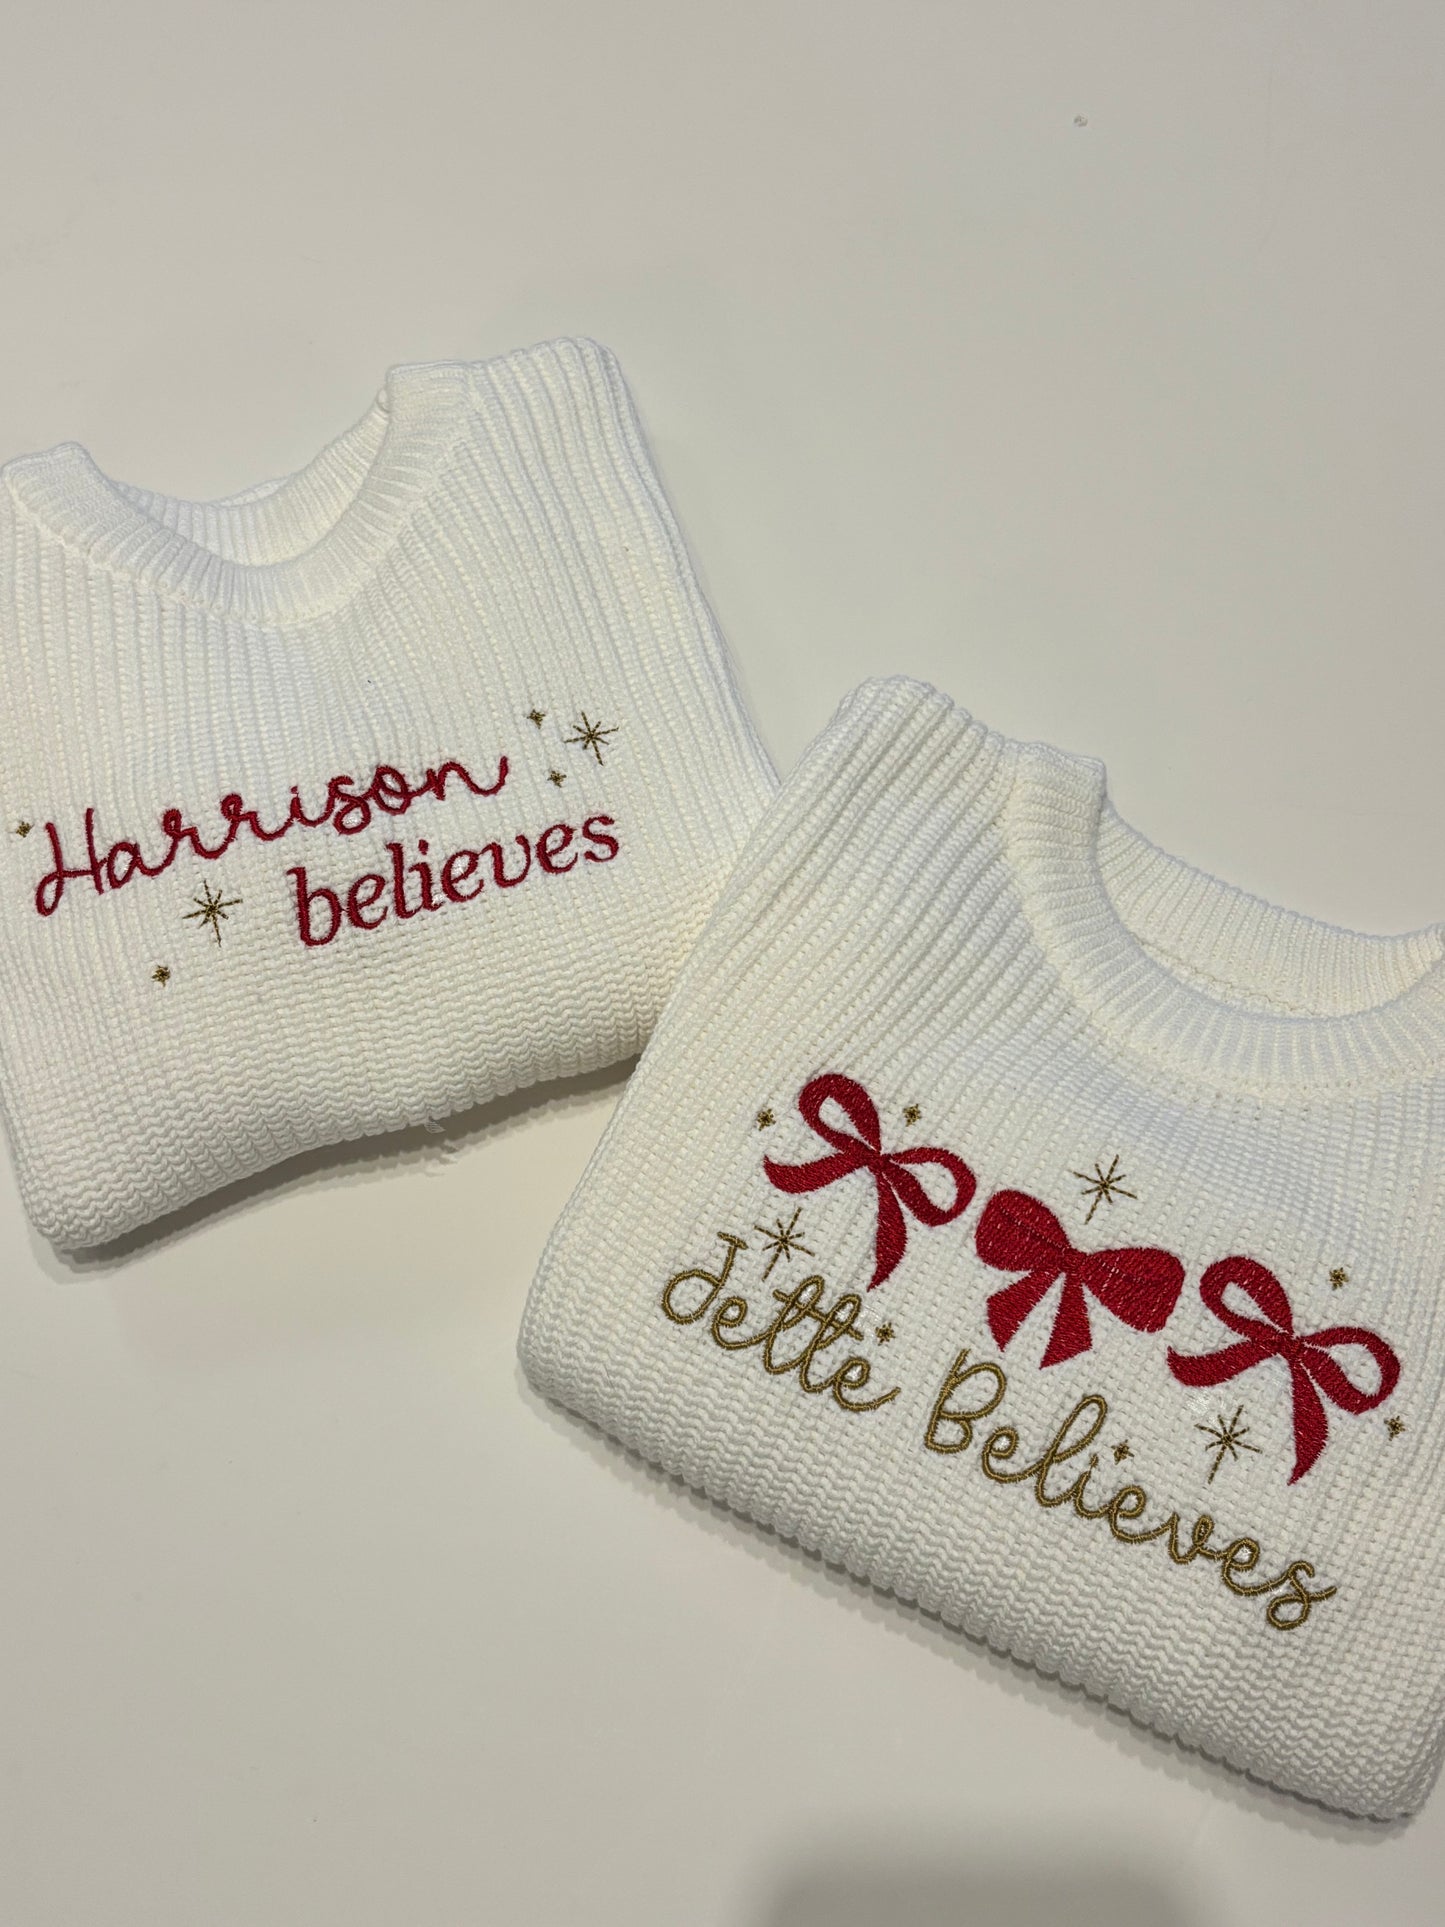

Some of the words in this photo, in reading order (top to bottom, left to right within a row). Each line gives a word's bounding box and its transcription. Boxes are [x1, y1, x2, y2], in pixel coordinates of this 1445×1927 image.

[35, 755, 509, 917] Harrison
[286, 815, 620, 947] believes
[661, 1231, 901, 1413] Jette
[924, 1349, 1338, 1631] Believes
